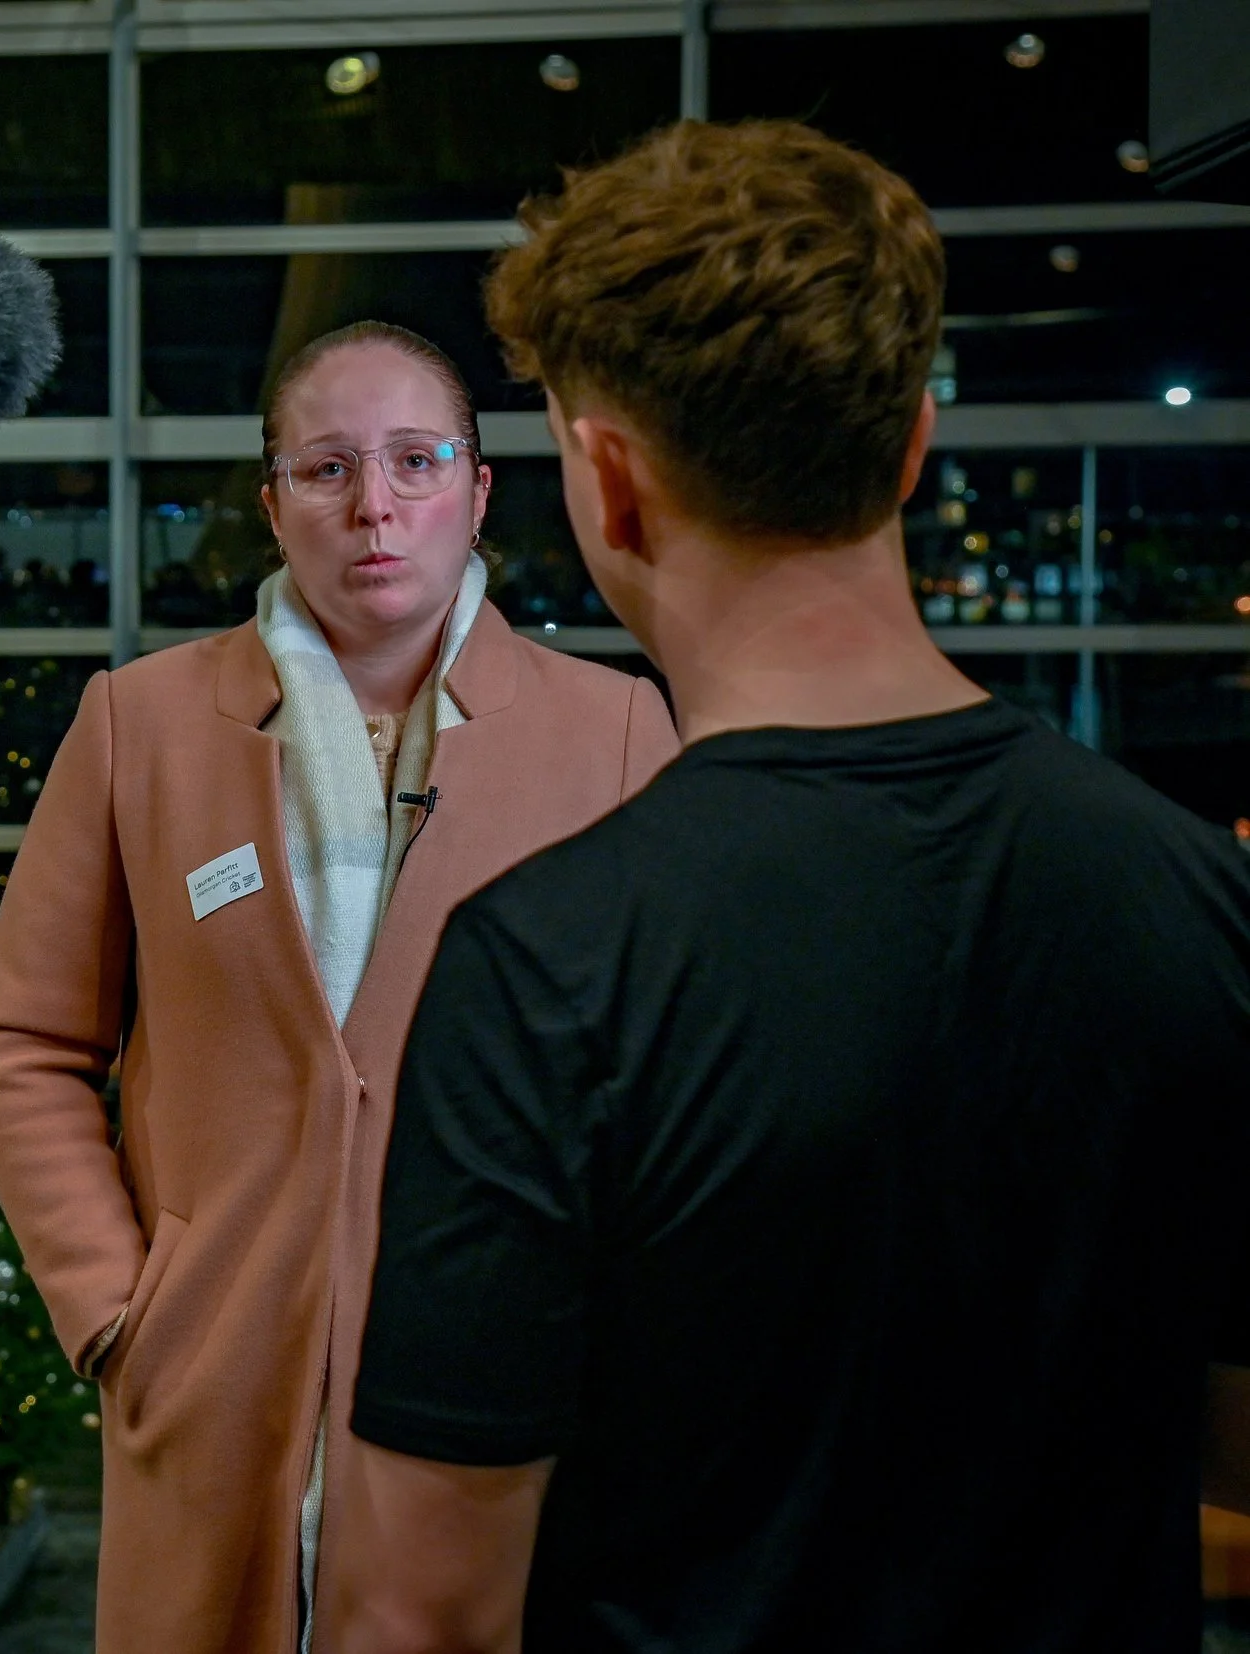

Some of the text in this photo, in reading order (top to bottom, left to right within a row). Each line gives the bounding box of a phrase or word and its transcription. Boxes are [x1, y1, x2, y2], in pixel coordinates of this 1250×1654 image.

[194, 862, 239, 891] Lauren Parfitt
[196, 881, 222, 898] Glamorgan
[222, 871, 241, 884] Cricket
